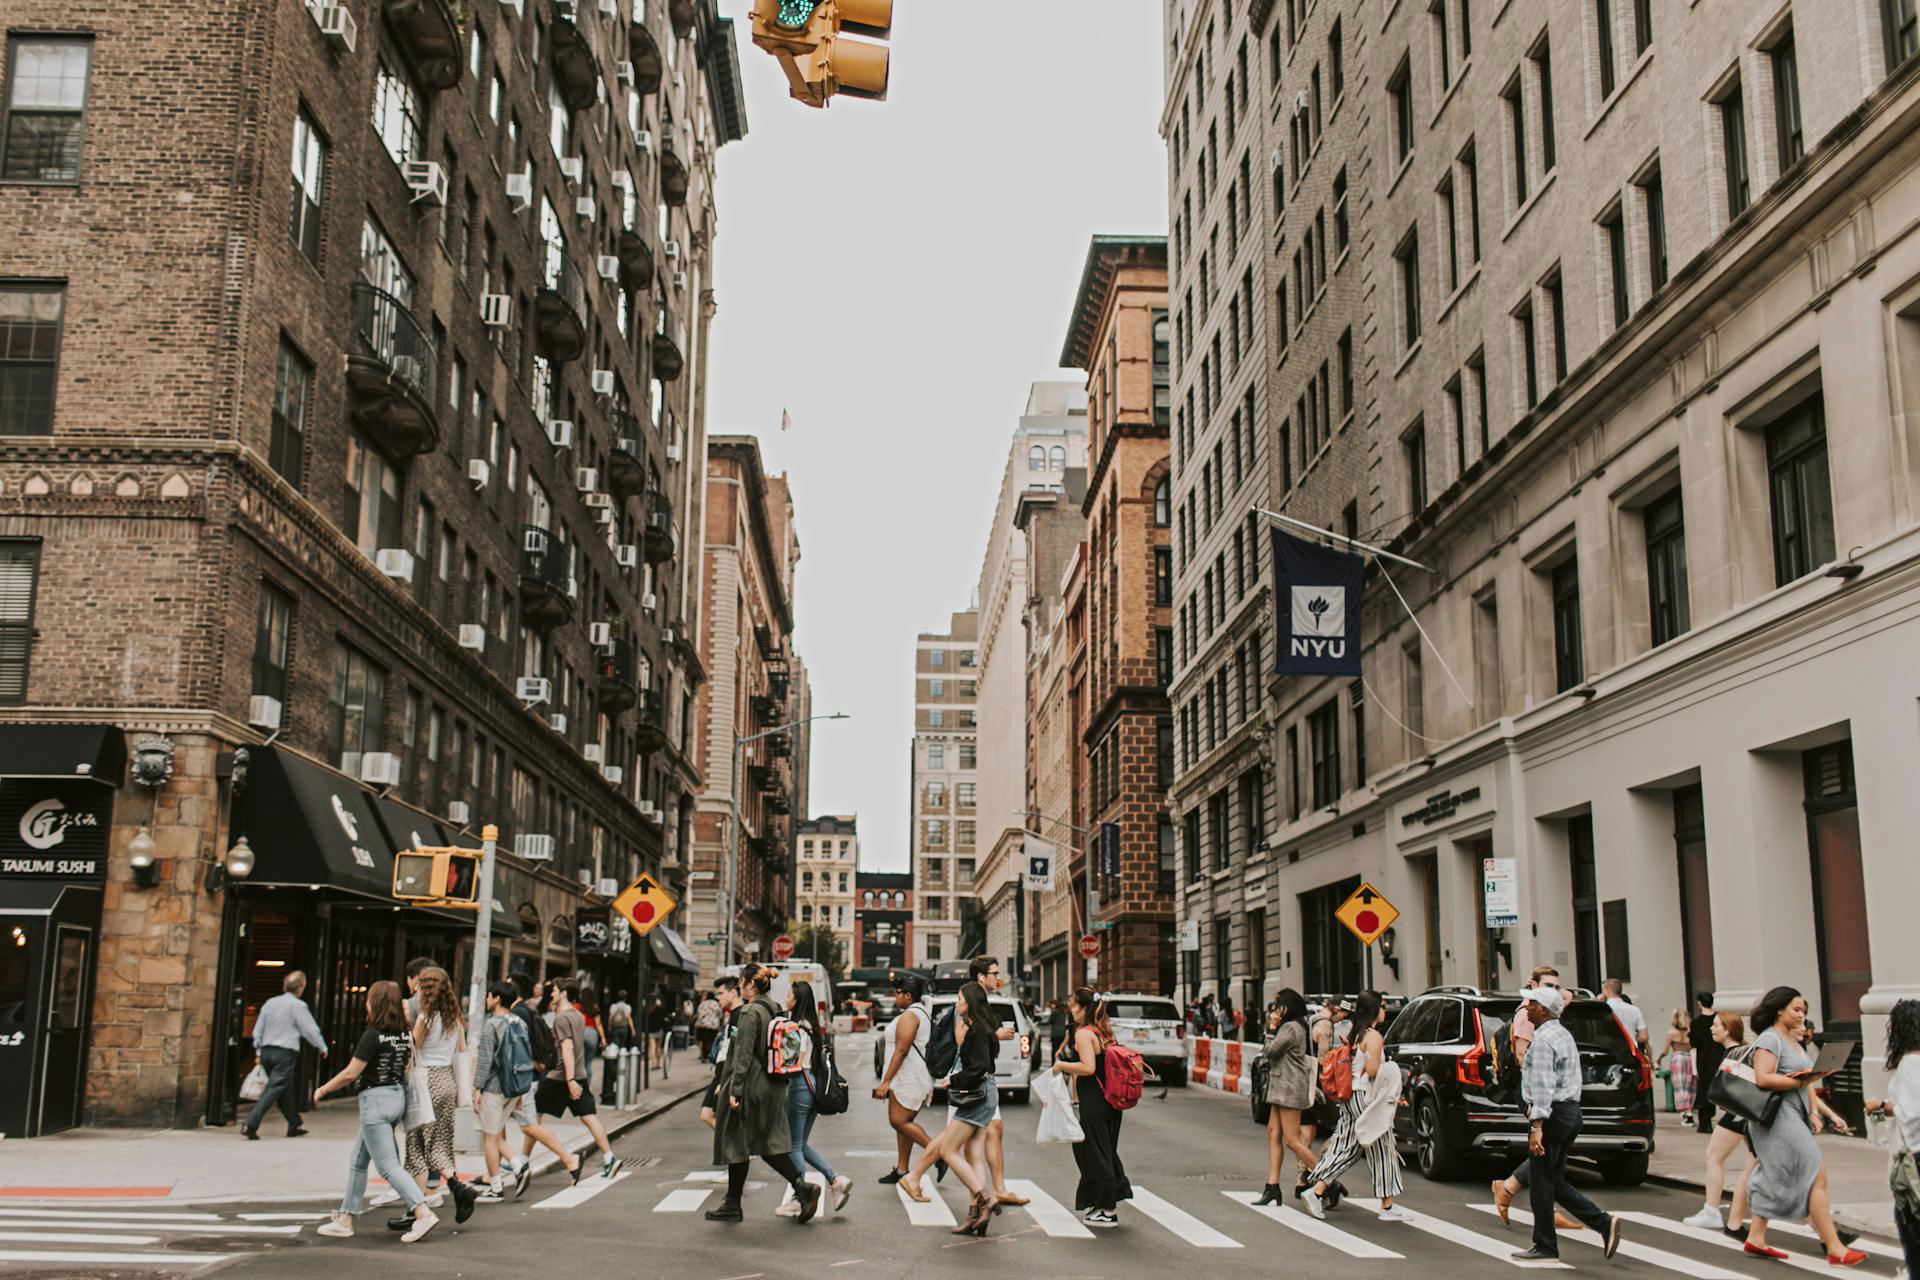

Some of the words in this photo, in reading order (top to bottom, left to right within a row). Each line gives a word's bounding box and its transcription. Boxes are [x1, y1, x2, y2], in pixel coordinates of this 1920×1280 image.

[1291, 638, 1345, 658] NYU
[2, 859, 54, 873] TAKUMI
[57, 860, 96, 874] SUSHI
[1029, 876, 1049, 884] NYU
[774, 942, 793, 951] STOP
[1080, 941, 1099, 950] STOP
